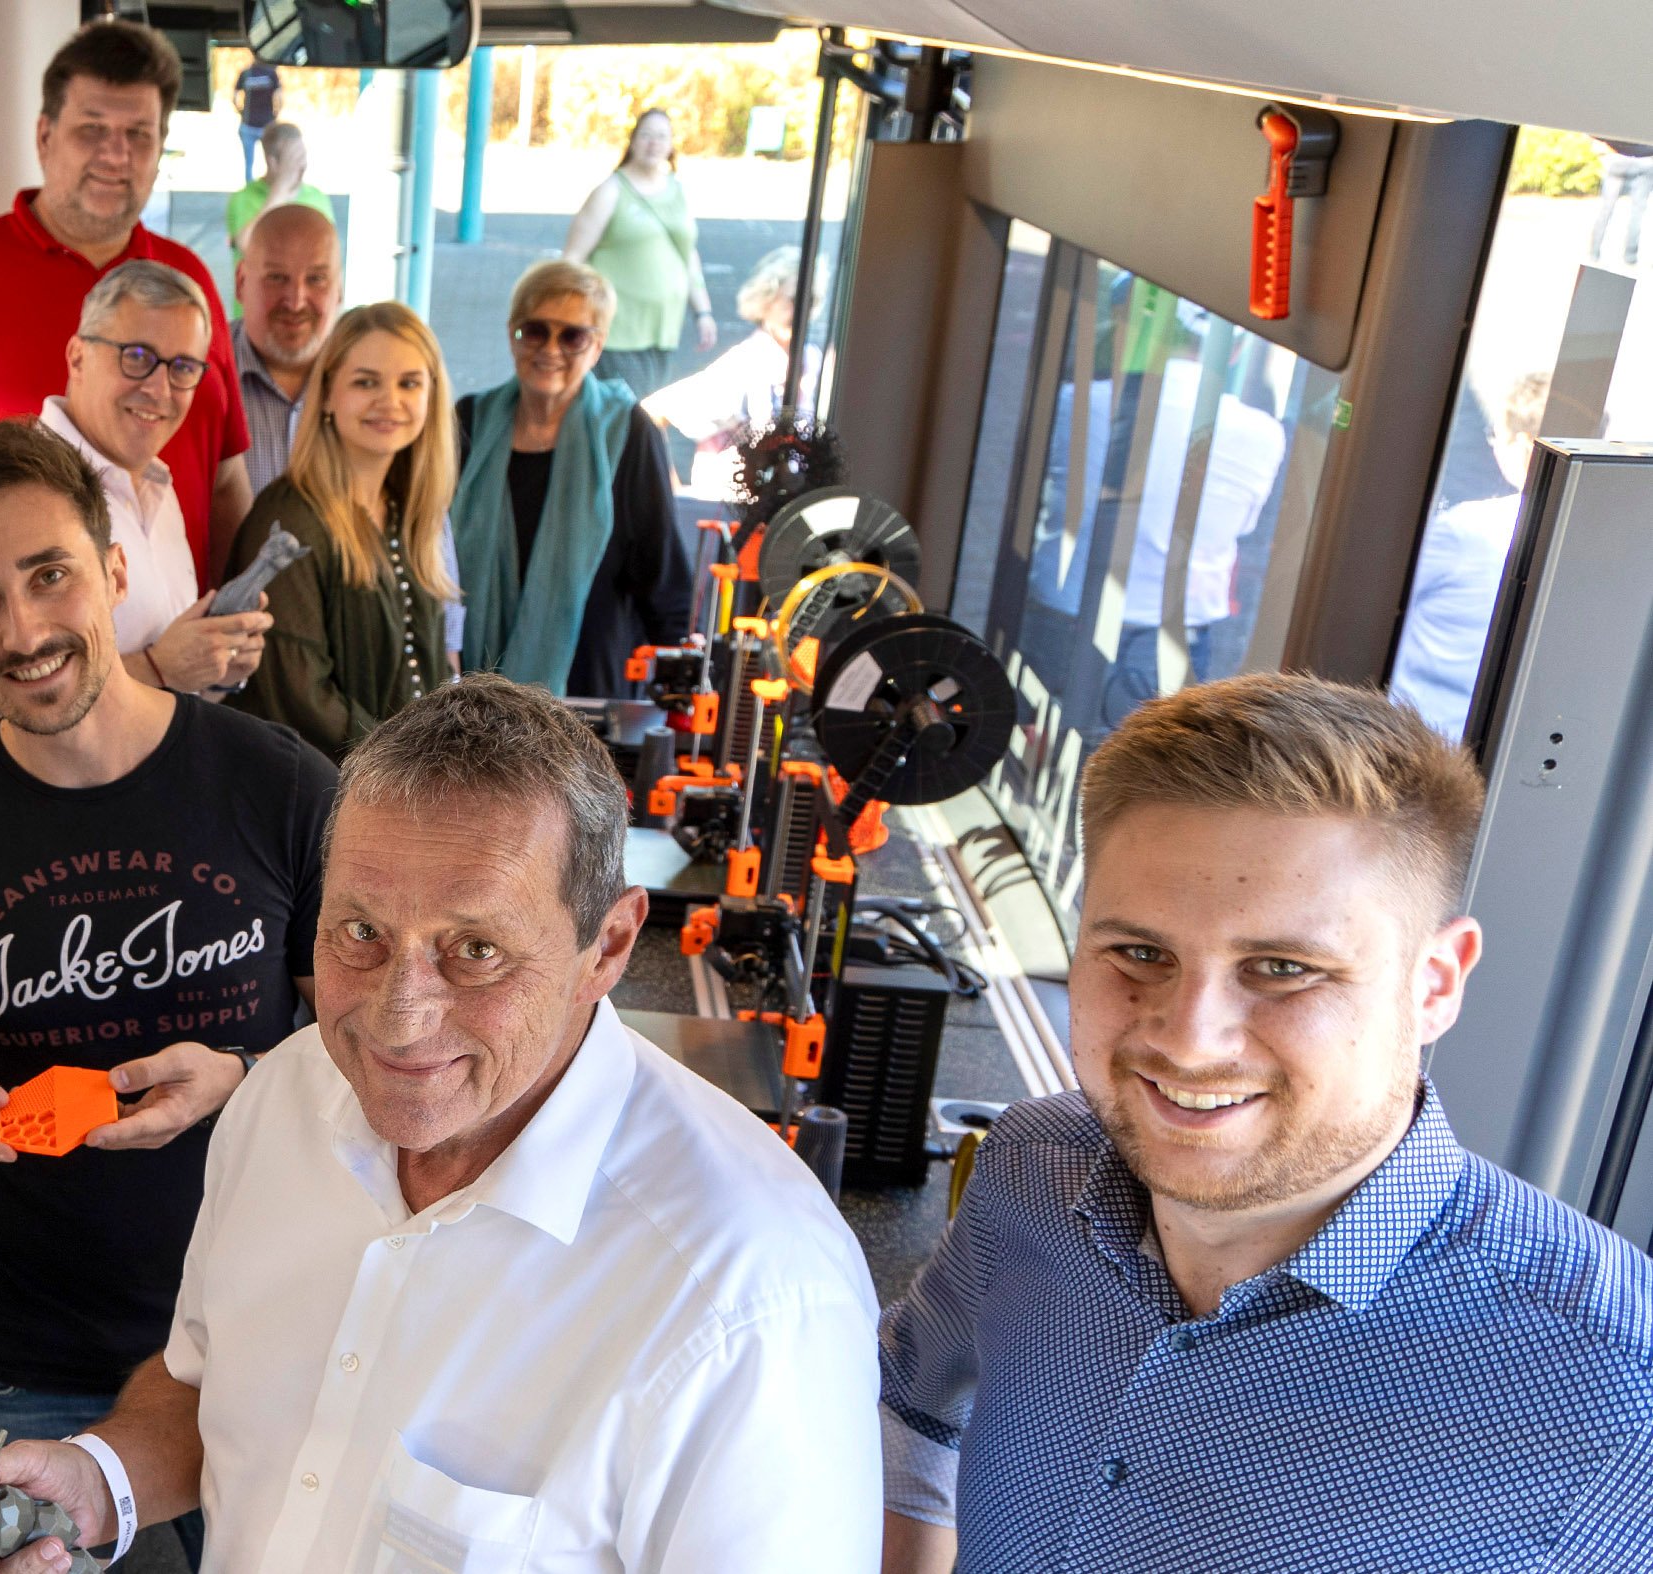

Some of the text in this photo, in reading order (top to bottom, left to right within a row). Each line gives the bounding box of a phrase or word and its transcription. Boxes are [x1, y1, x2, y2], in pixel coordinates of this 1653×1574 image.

[48, 883, 161, 908] TRADEMARK
[191, 862, 242, 906] CO.
[156, 997, 261, 1034] SUPPLY
